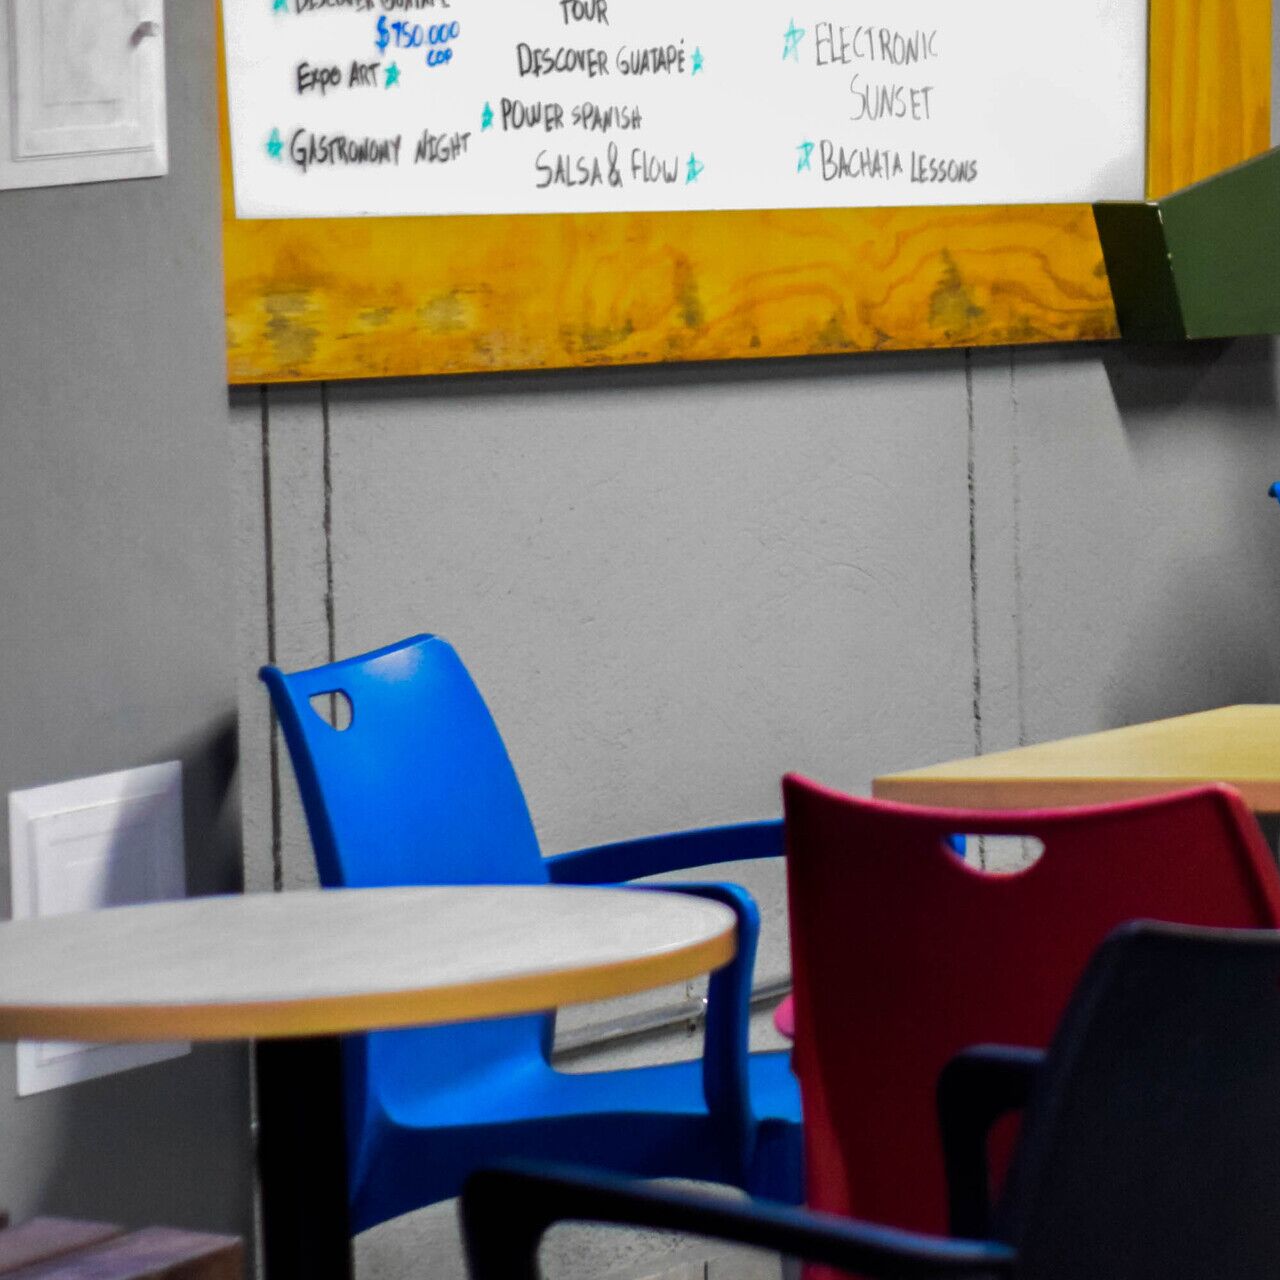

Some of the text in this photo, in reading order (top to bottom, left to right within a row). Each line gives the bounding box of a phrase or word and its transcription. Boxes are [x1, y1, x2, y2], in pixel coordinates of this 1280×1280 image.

[517, 42, 609, 78] DISCOVER
[815, 22, 938, 66] ELECTRONIC
[350, 61, 380, 88] ART
[500, 97, 642, 133] POWER SPANISH
[850, 73, 934, 121] SUNSET
[290, 128, 471, 172] GASTRONOMY NIGHT
[535, 141, 678, 188] SALSA & FLOW
[820, 139, 978, 184] BACHATA LESSONS
